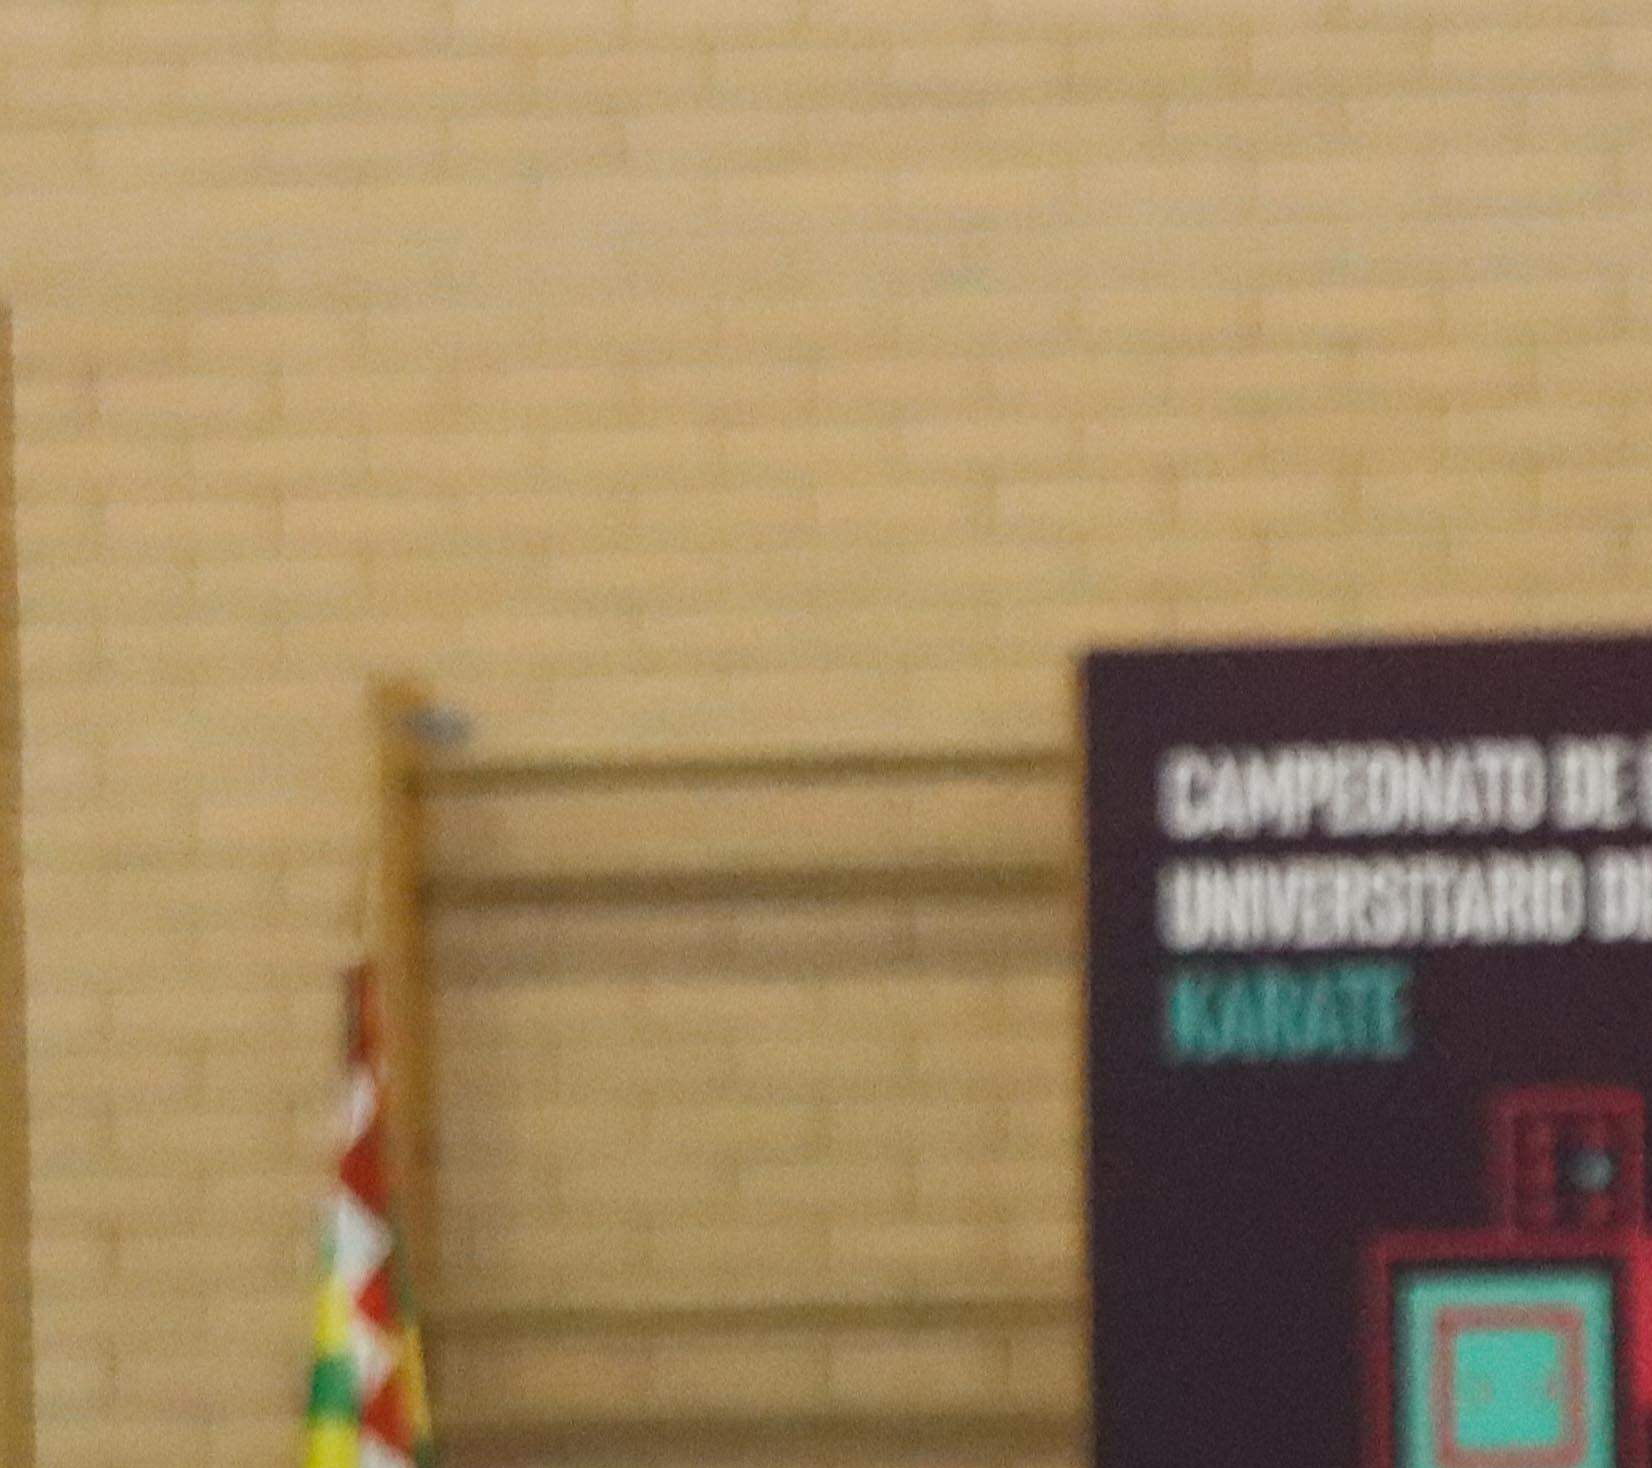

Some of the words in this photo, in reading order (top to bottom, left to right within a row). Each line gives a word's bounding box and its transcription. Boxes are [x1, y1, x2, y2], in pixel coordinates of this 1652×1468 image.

[1160, 738, 1544, 838] CAMPEONATO
[1552, 736, 1637, 830] DE
[1160, 850, 1583, 949] UNIVERSITARIO
